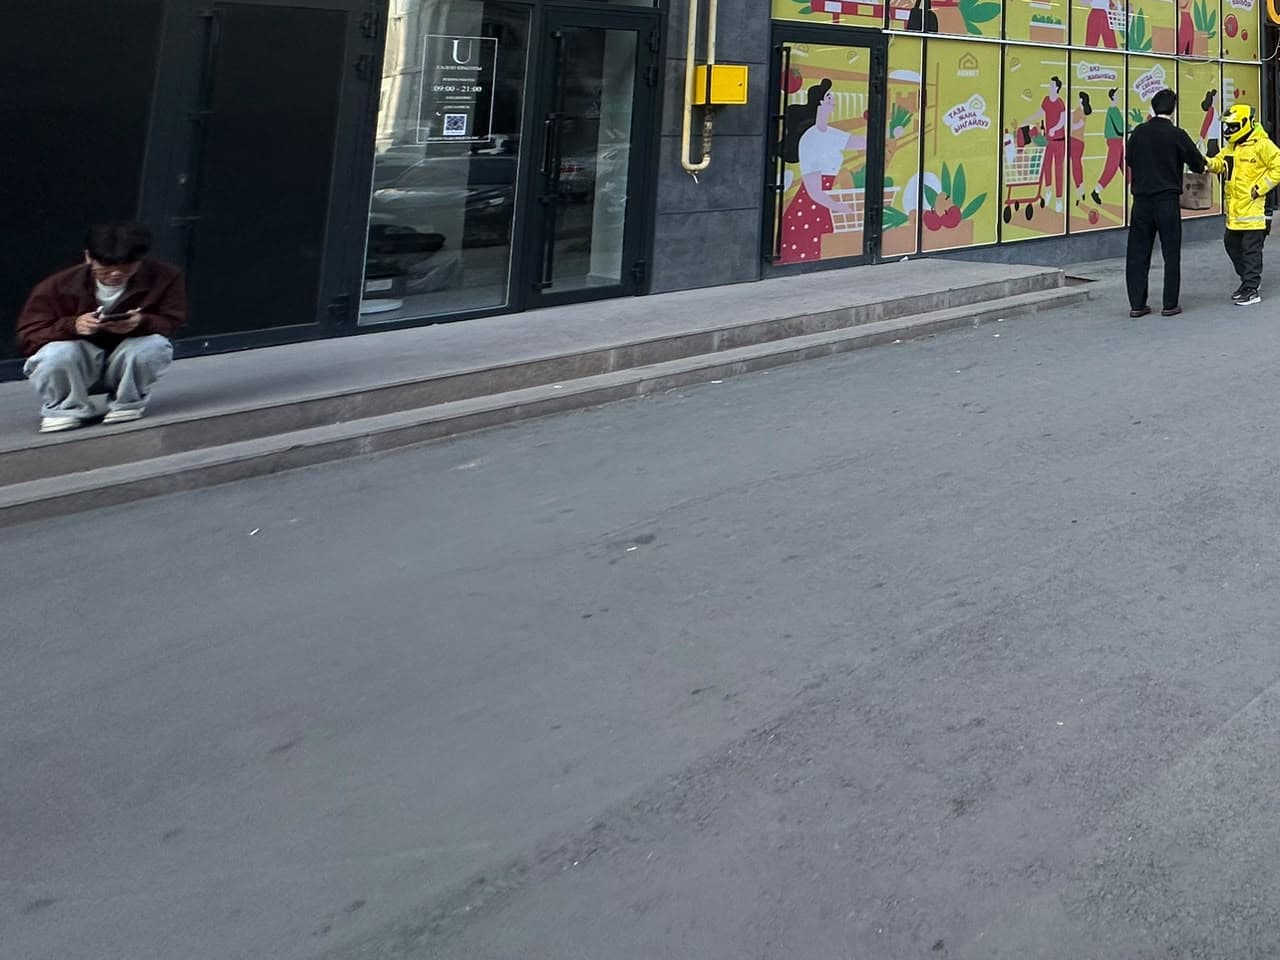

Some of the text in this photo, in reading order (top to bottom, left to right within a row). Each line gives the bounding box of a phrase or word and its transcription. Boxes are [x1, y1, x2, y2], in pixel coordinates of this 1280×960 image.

[453, 40, 472, 64] U
[949, 106, 966, 119] ТАЗА
[959, 112, 977, 121] ЖАНА
